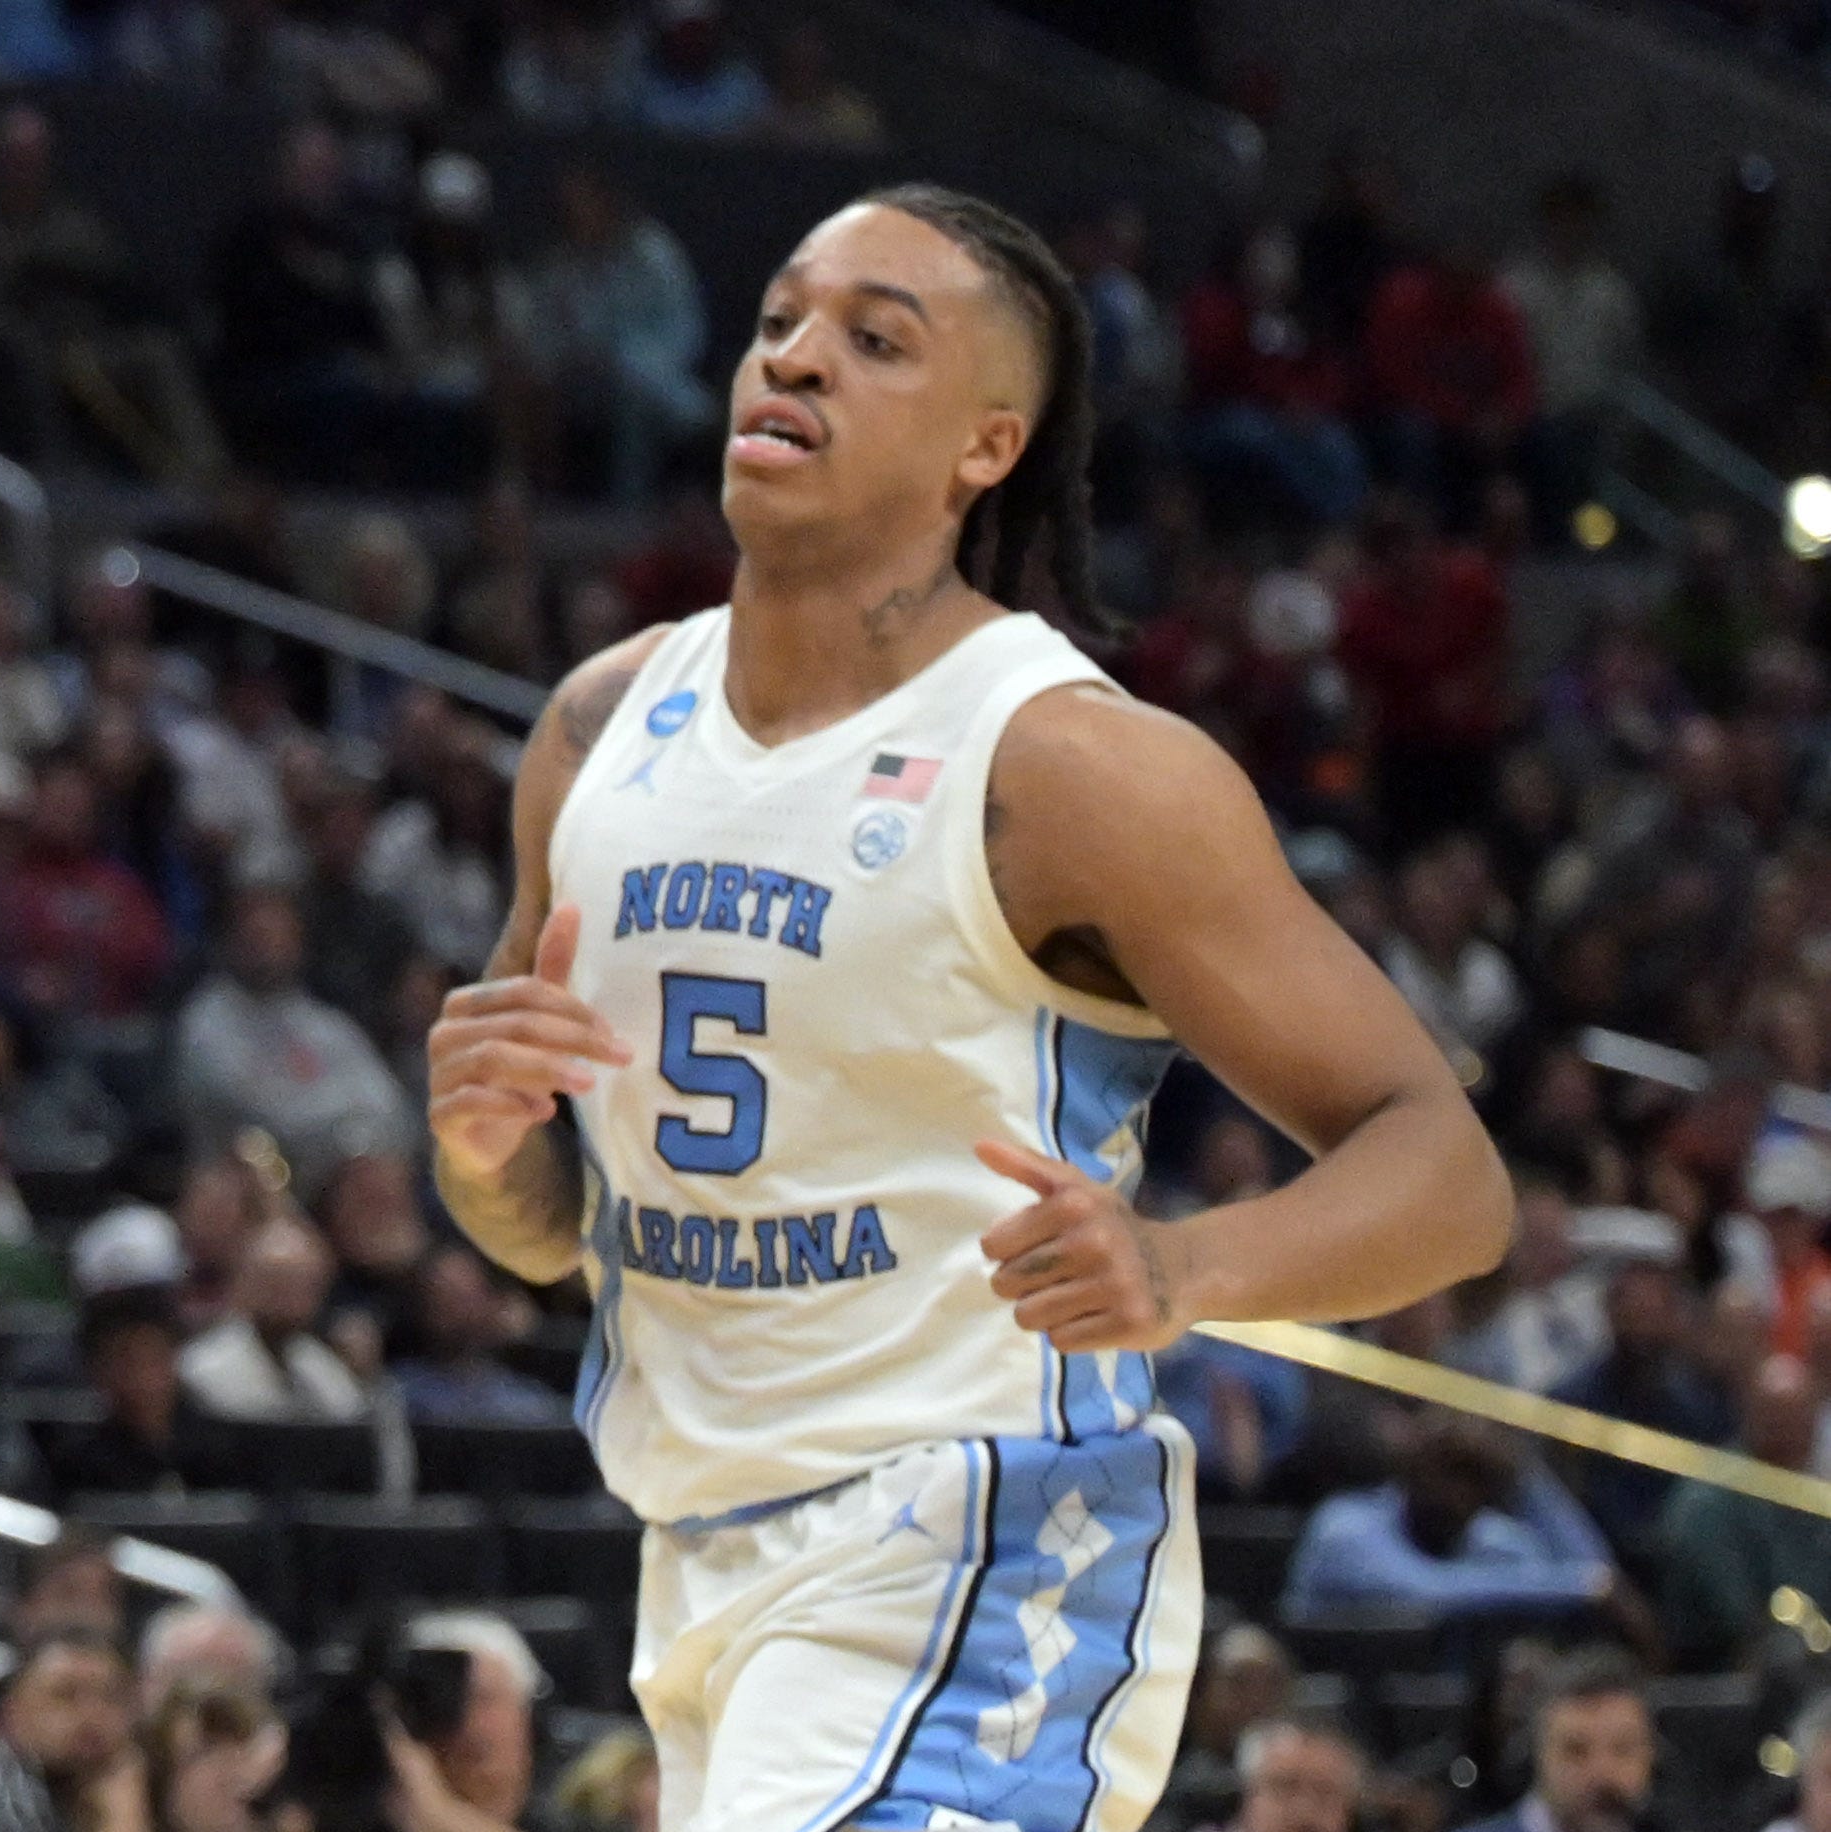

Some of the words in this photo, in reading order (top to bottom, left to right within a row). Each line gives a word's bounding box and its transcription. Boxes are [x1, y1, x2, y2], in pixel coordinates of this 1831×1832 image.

[614, 860, 833, 960] NORTH
[654, 970, 769, 1178] 5
[618, 1196, 897, 1288] AROLINA
